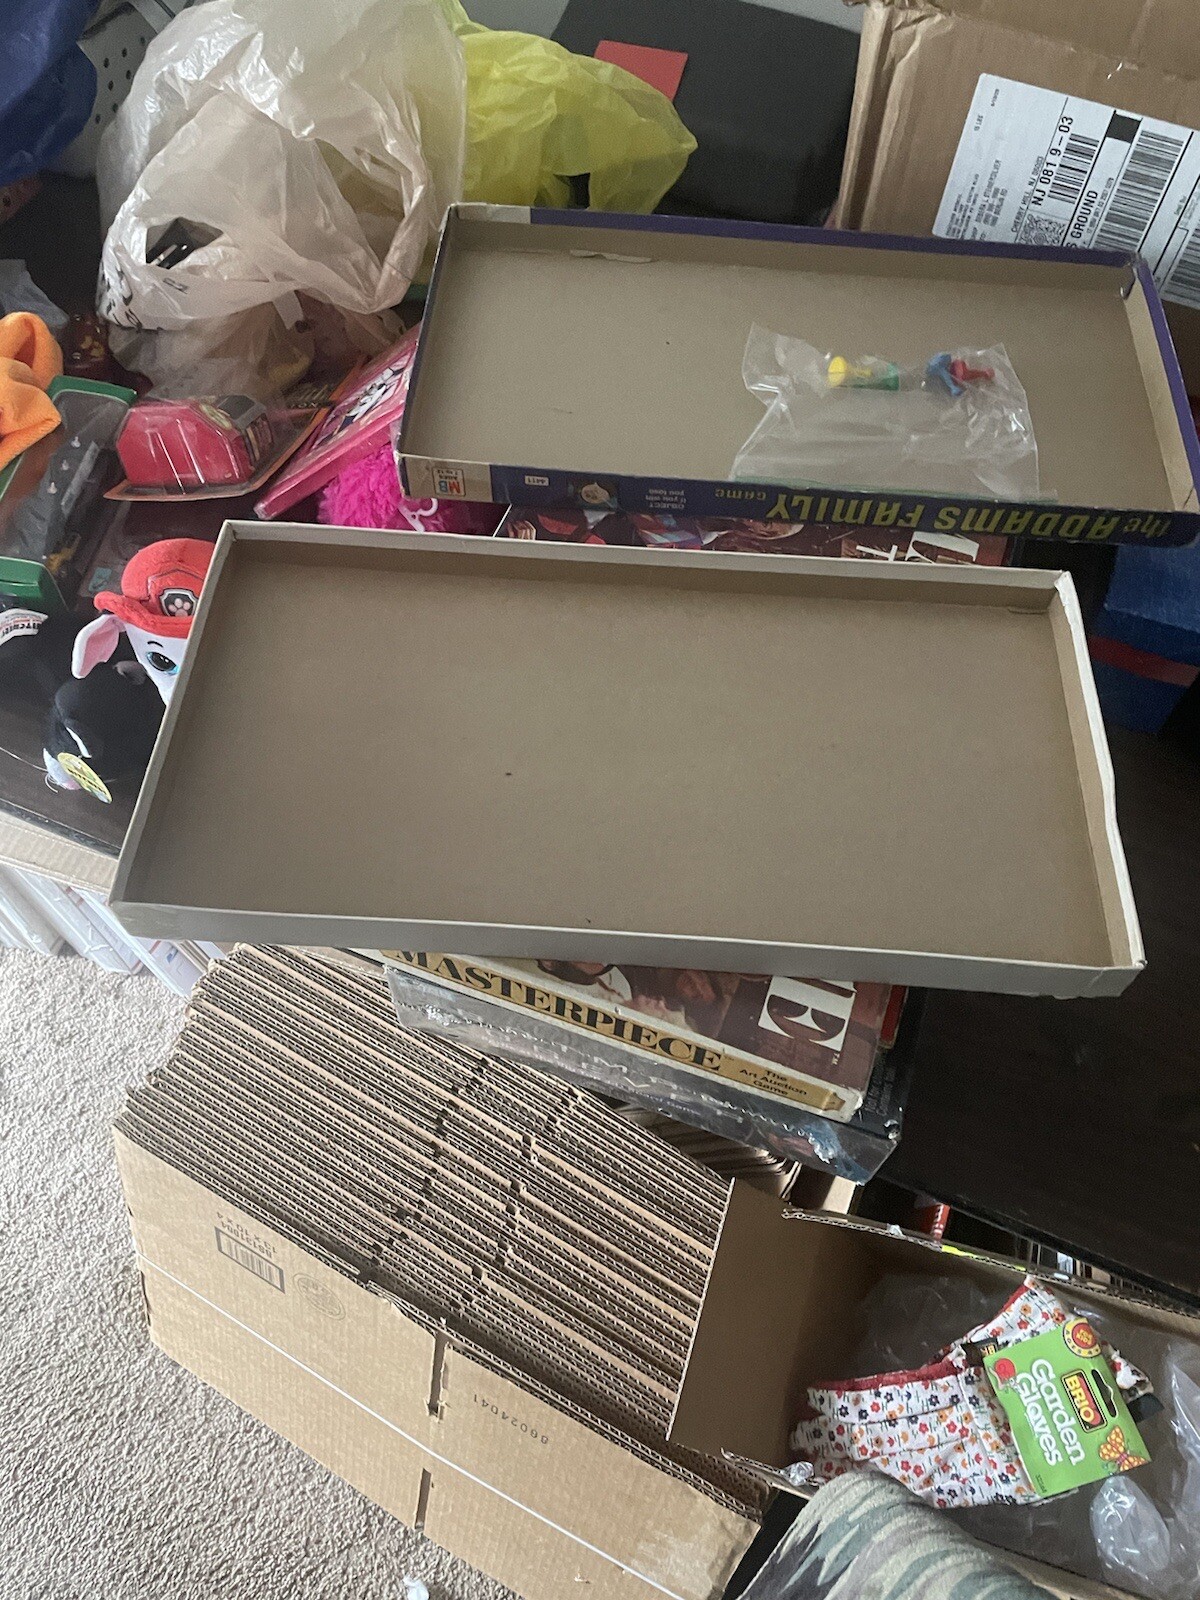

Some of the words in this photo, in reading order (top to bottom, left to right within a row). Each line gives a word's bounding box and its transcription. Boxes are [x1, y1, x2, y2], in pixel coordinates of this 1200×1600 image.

[1031, 188, 1047, 207] NJ
[1070, 189, 1099, 240] GROUND
[438, 480, 461, 495] MB
[766, 493, 925, 529] FAMILY
[933, 504, 1120, 540] ADDAMS
[396, 950, 723, 1072] MASTERPIECE
[740, 1068, 757, 1079] Art
[760, 1074, 808, 1096] Auction
[753, 1080, 789, 1096] Game
[765, 1069, 788, 1082] The
[1031, 1358, 1087, 1467] Garden
[1063, 1375, 1095, 1424] BRIO
[1015, 1371, 1064, 1467] Gloves
